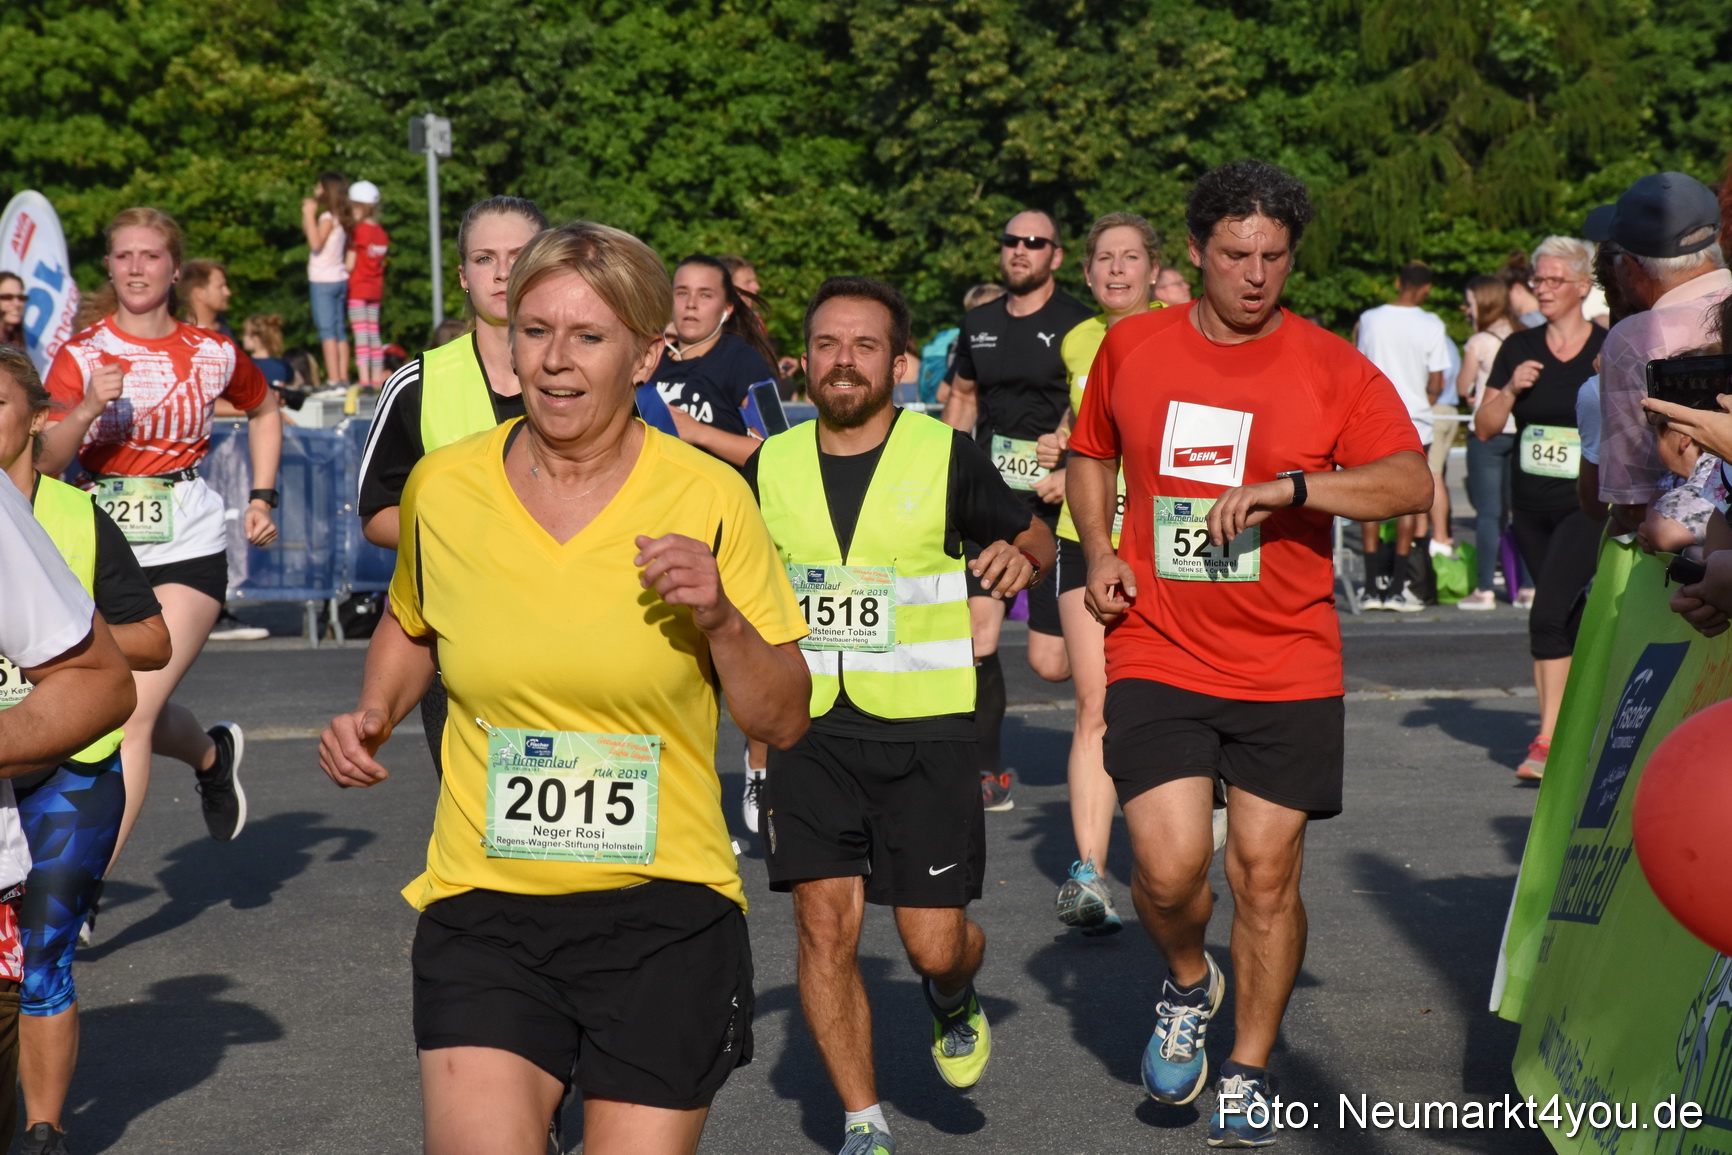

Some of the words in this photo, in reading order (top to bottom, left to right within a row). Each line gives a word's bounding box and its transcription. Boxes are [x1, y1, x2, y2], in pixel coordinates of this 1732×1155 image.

[1189, 451, 1218, 462] DEHN
[1532, 444, 1568, 463] 845
[998, 455, 1040, 477] 2402
[105, 501, 162, 523] 2213
[1172, 558, 1202, 567] Mohren
[1204, 560, 1237, 568] Michael
[798, 595, 880, 628] 1518
[808, 628, 846, 637] olfsteiner
[848, 628, 877, 637] Tobias
[823, 636, 869, 644] Postbauer-Heng
[512, 753, 580, 769] firmenlauf
[618, 769, 648, 779] 2019
[505, 776, 635, 826] 2015
[533, 825, 571, 839] Neger
[575, 828, 605, 839] Rosi
[496, 836, 599, 850] Regens-Wagner-Stiftung
[602, 842, 643, 850] Holnstein
